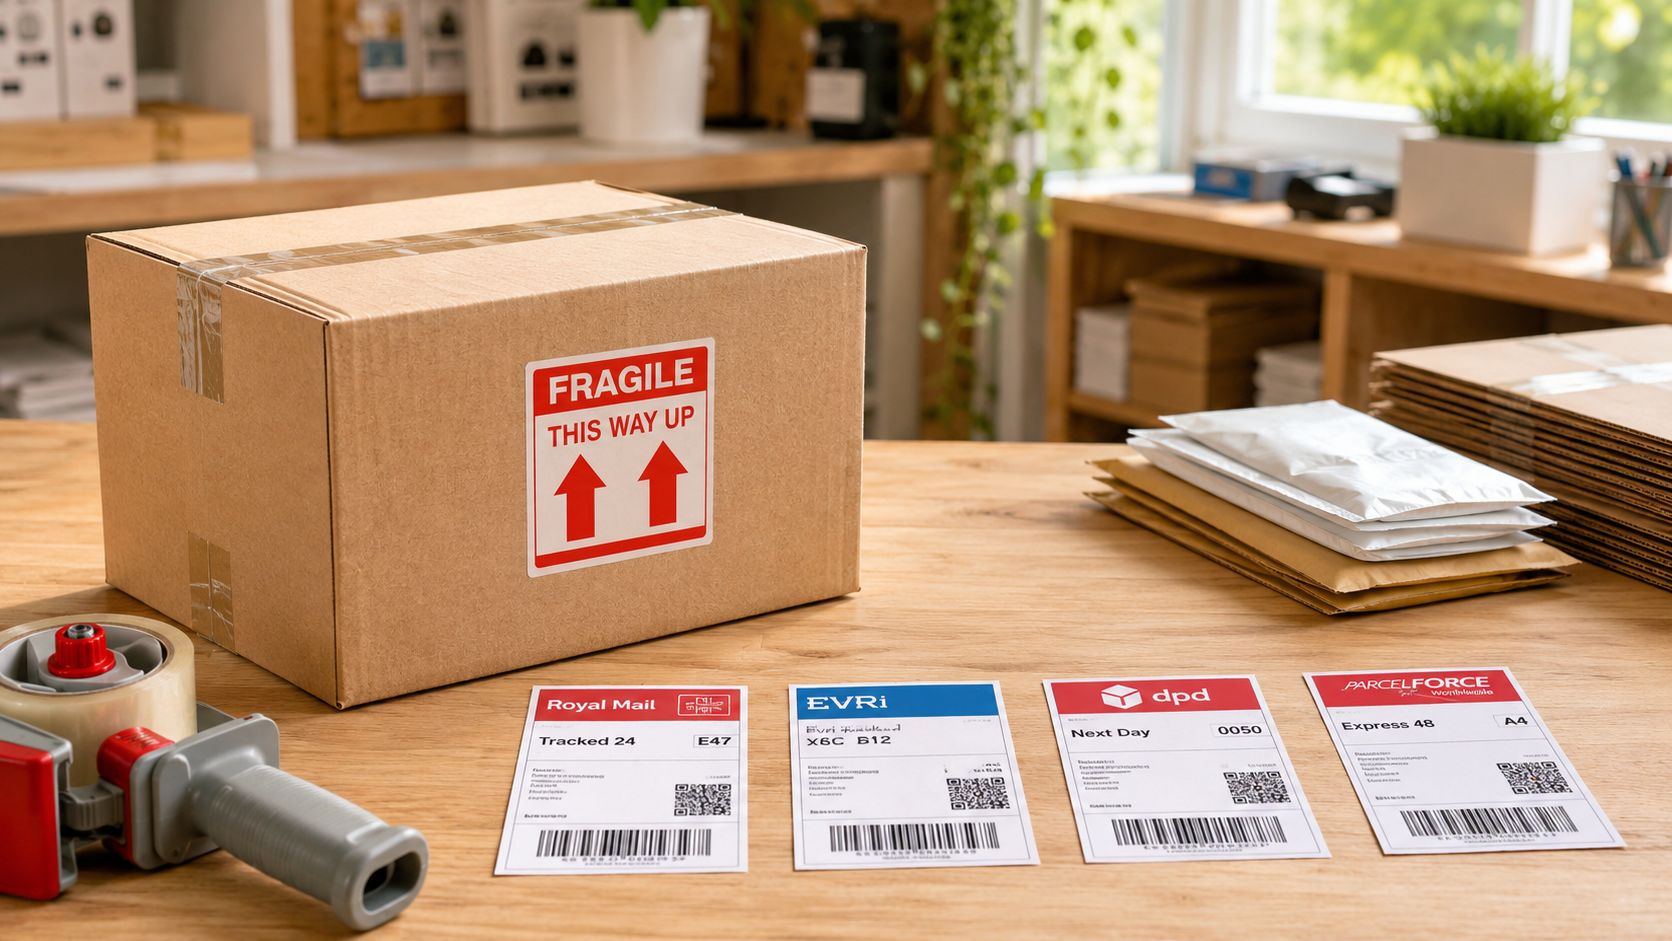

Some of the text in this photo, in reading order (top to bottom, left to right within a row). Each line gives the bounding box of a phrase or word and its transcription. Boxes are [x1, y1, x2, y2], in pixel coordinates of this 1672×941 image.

[549, 357, 694, 405] FRAGILE
[548, 405, 695, 447] THIS WAY UP
[1344, 676, 1490, 690] PARCELFORCE
[806, 696, 888, 710] EVRi
[1152, 688, 1211, 706] dpd
[547, 699, 656, 713] Royal Mail
[1341, 719, 1435, 732] Express 48
[1504, 716, 1528, 726] A4
[1070, 728, 1150, 740] Next Day
[1217, 725, 1262, 735] 0050
[539, 736, 636, 746] Tracked 24
[698, 736, 732, 746] E47
